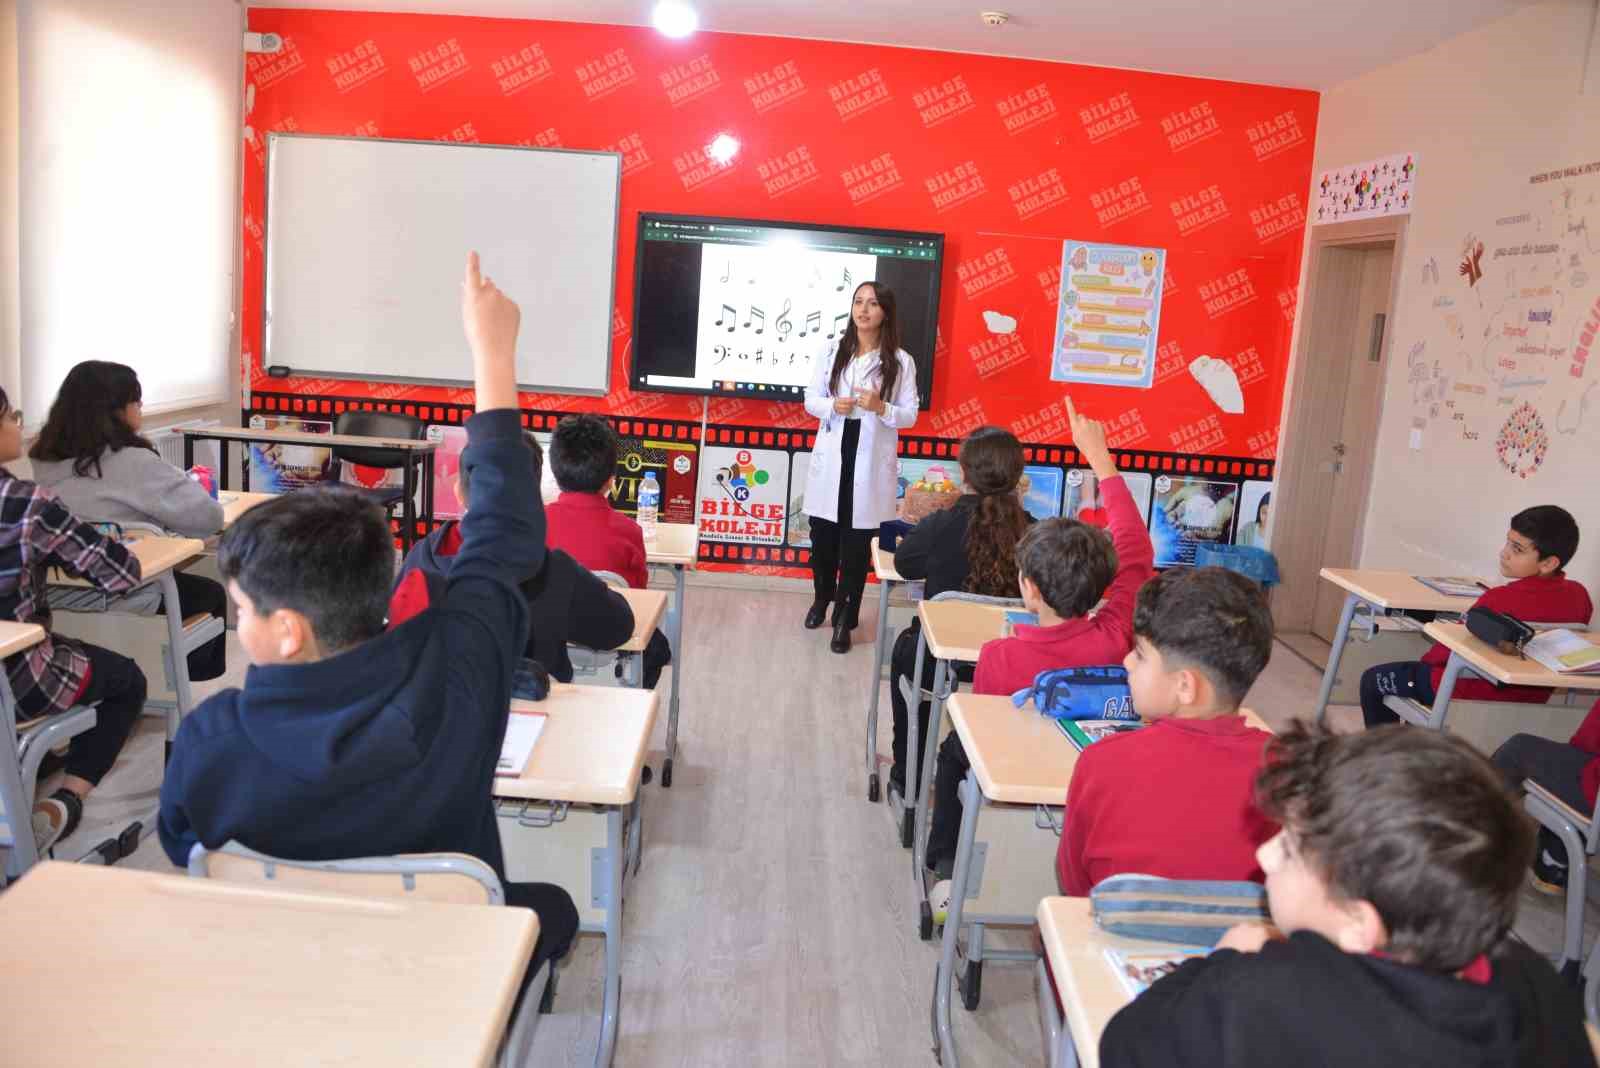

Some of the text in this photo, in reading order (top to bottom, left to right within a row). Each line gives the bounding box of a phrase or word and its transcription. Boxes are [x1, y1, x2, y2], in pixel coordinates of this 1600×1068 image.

[738, 489, 747, 498] K
[701, 498, 784, 519] BİLGE
[699, 519, 782, 537] KOLEJİ
